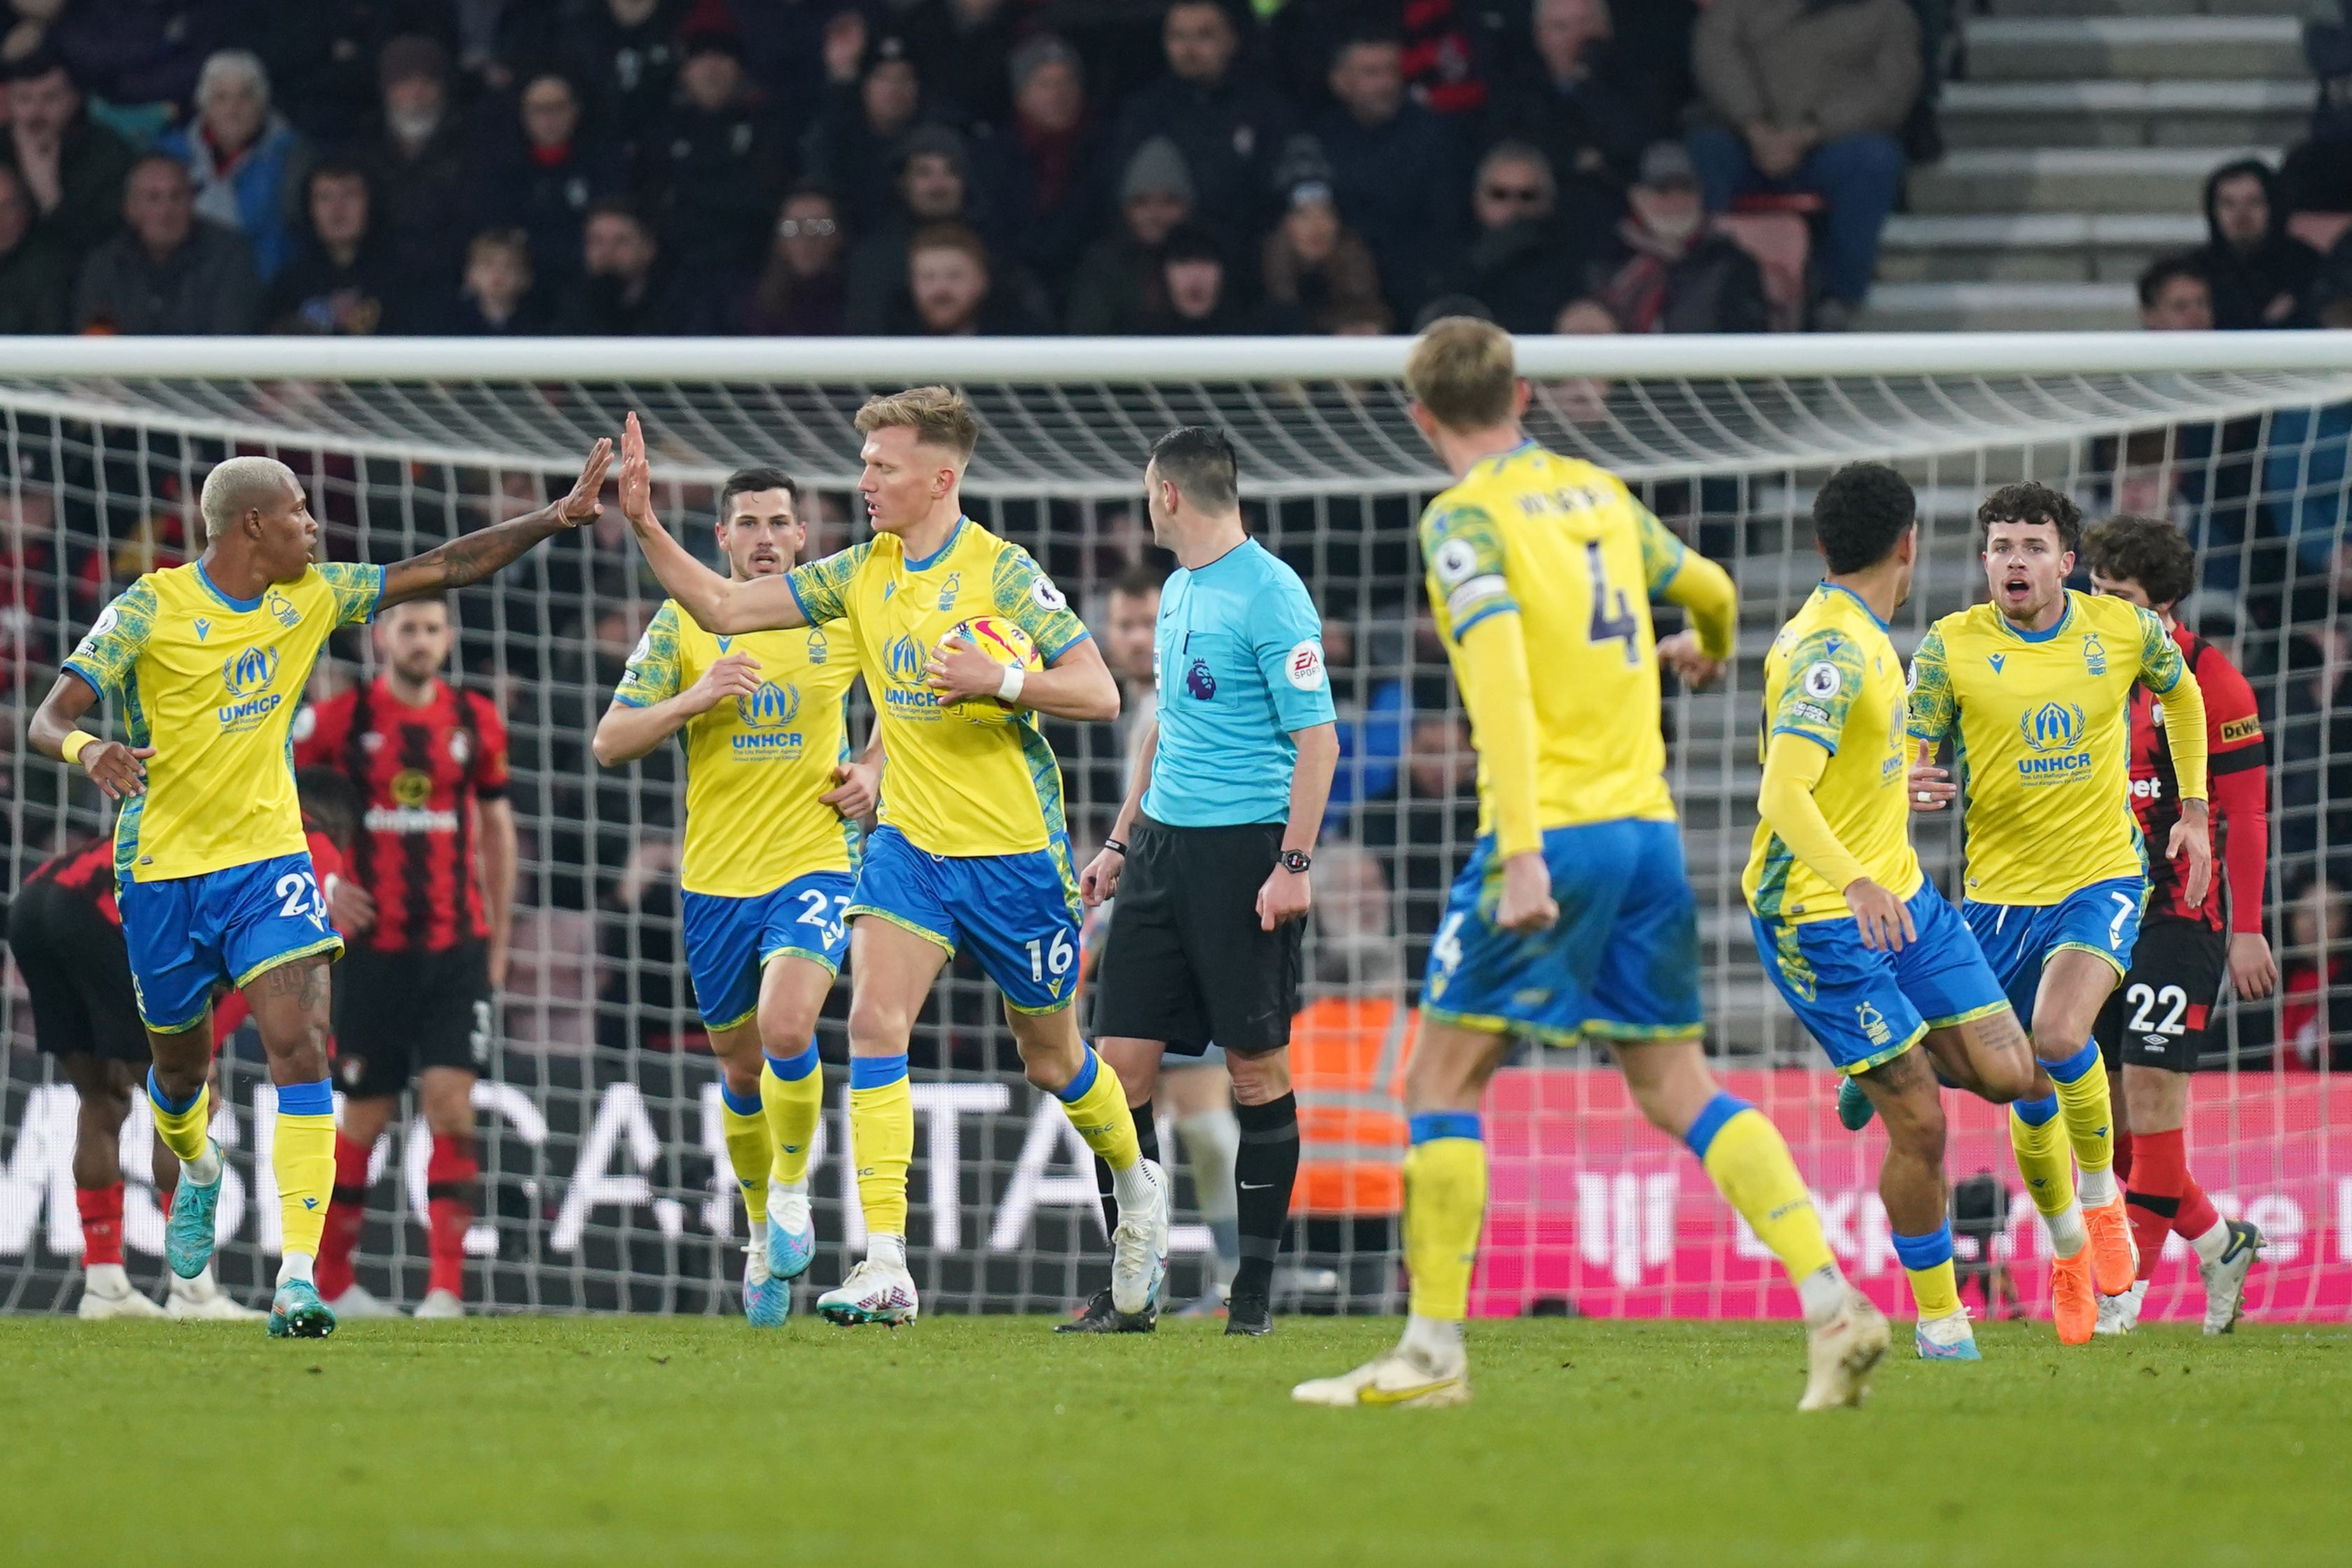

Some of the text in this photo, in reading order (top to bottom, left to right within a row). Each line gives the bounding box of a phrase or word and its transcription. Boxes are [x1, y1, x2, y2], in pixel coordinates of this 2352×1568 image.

[1587, 539, 1638, 663] 4
[1295, 649, 1319, 670] EA
[732, 732, 802, 748] UNHCR
[2019, 752, 2091, 773] UNHCR
[796, 888, 851, 939] 23
[2111, 890, 2135, 931] 7
[1025, 926, 1073, 982] 16
[1432, 912, 1464, 977] 4
[2126, 983, 2187, 1036] 22
